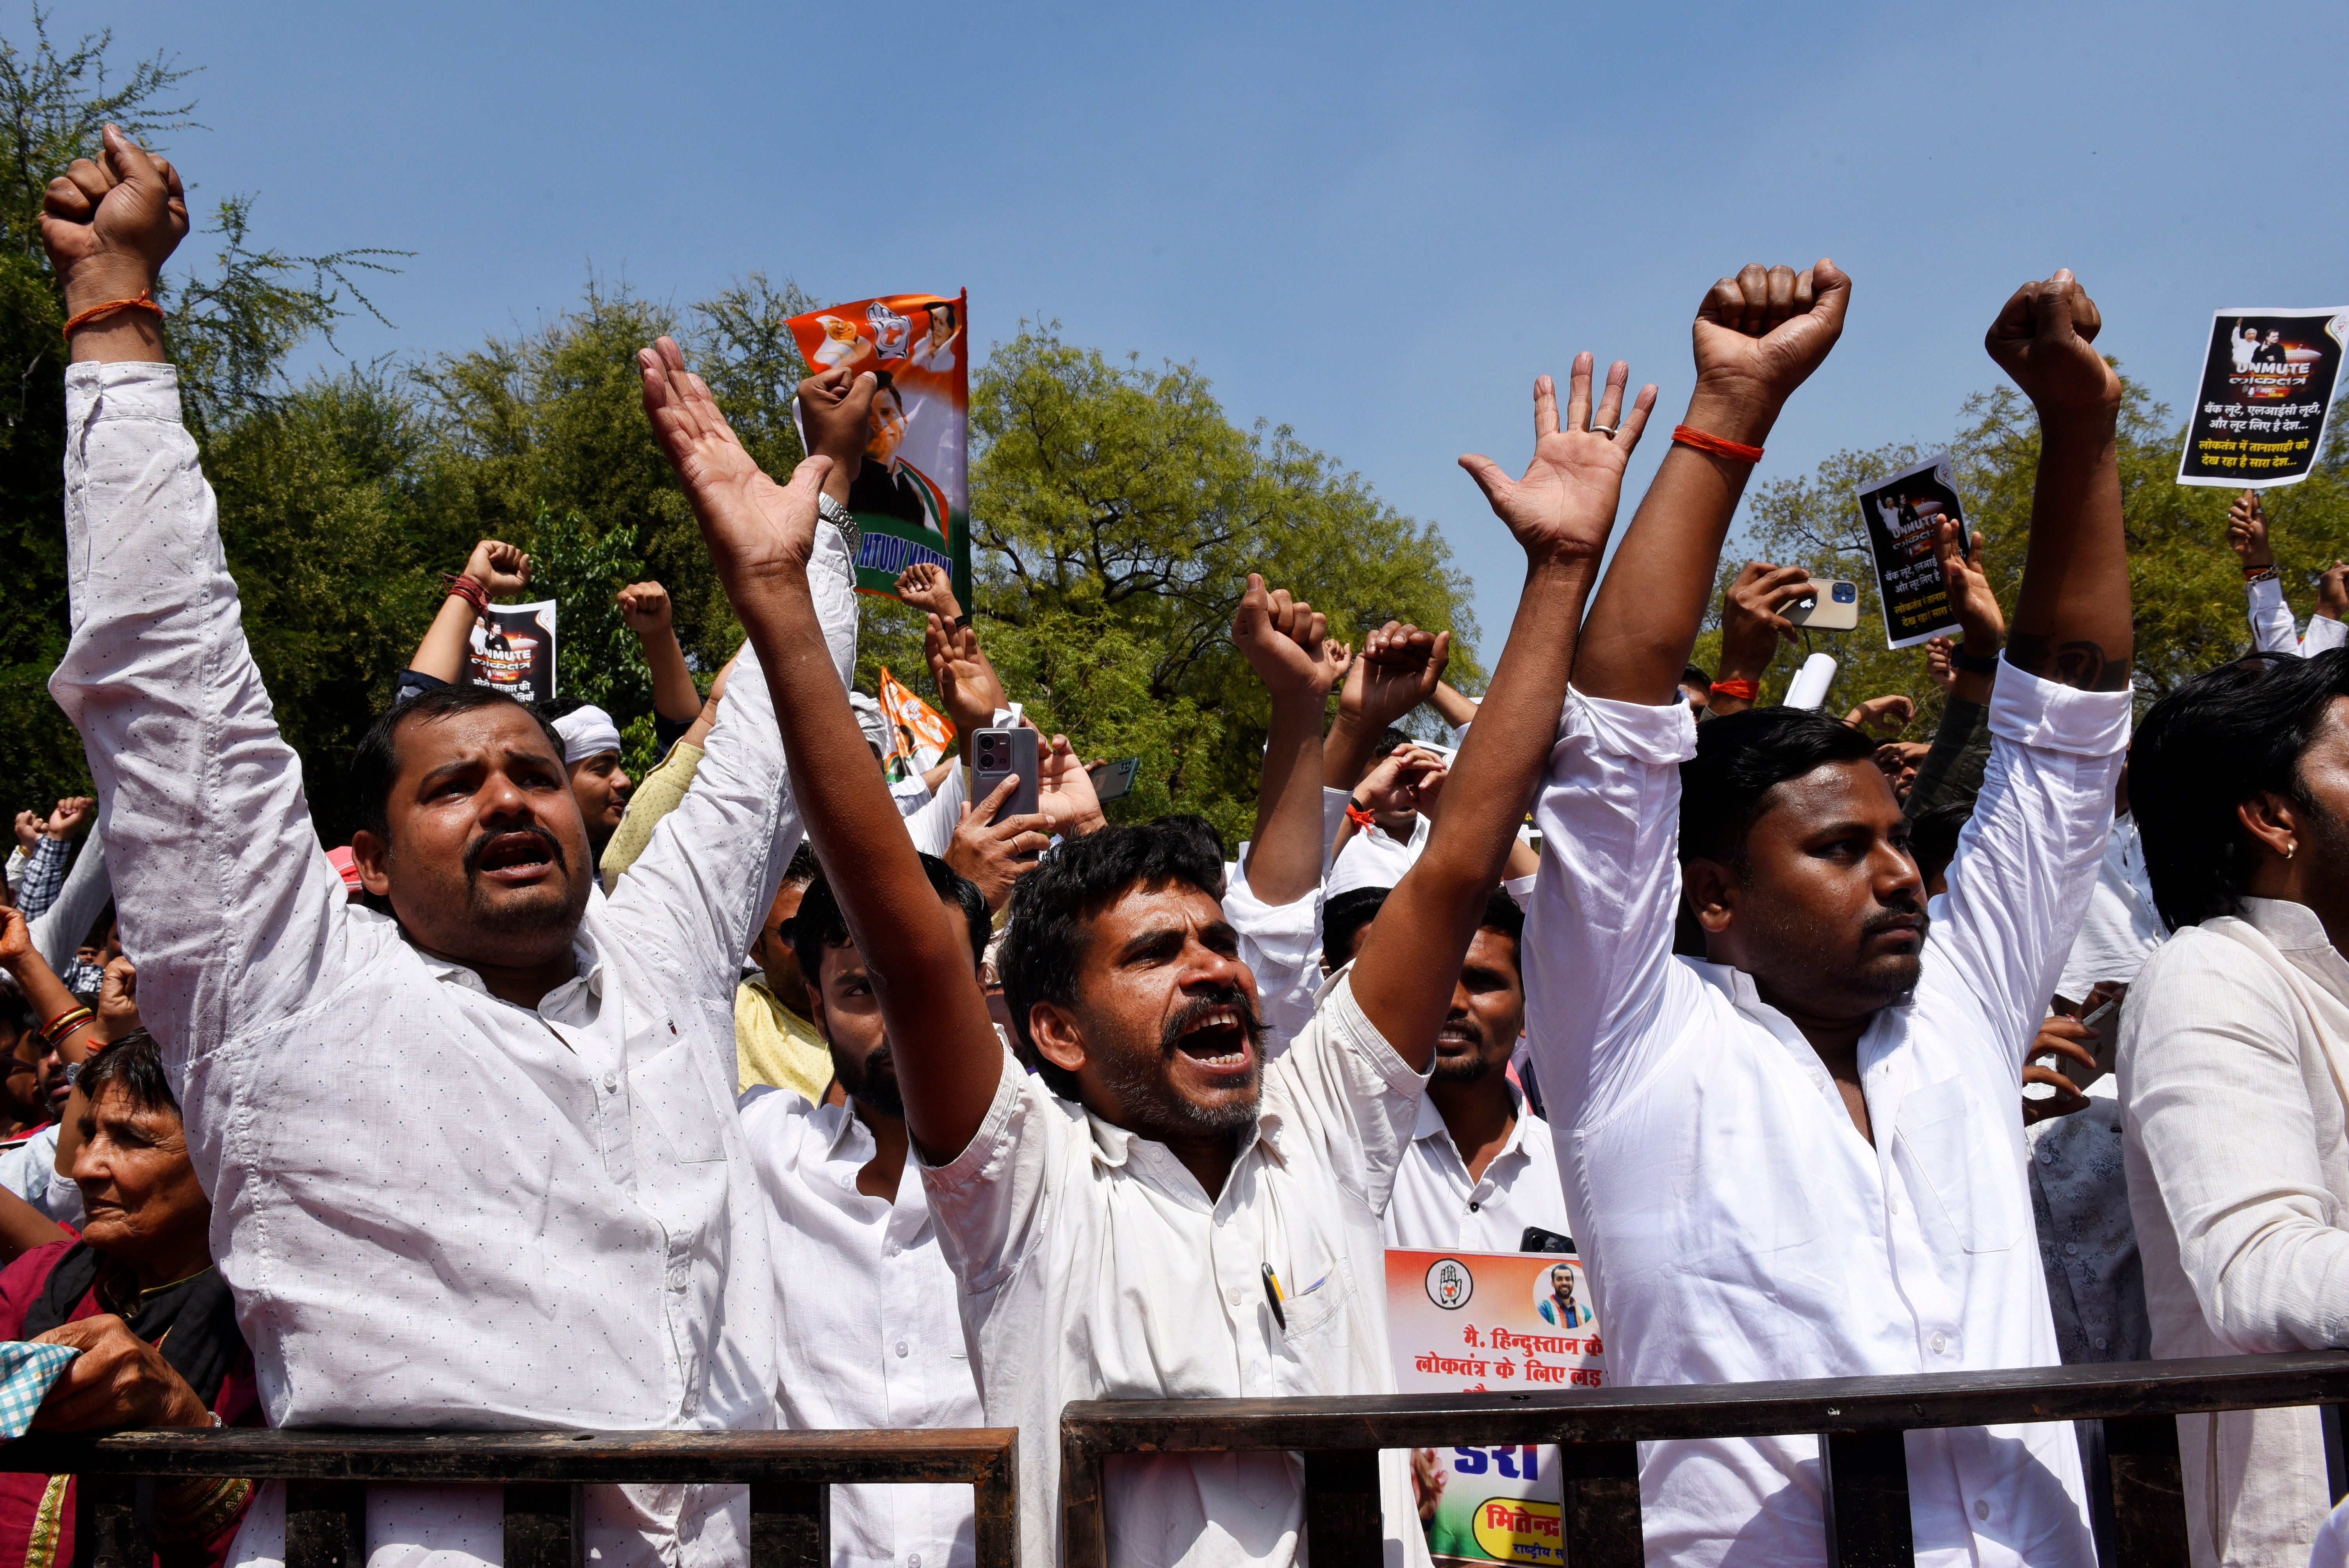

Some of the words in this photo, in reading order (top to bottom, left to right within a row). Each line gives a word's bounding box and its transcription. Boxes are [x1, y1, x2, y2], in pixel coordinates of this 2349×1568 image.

[2236, 362, 2310, 374] UNMUTE
[2204, 401, 2223, 414] बैंक
[2225, 402, 2244, 417] लूटे,
[2247, 403, 2297, 417] एलआईसी
[2299, 401, 2321, 417] लूटी,
[2209, 416, 2228, 429] और
[2230, 420, 2249, 433] लूट
[2249, 418, 2271, 433] लिए
[2272, 419, 2281, 432] है
[2199, 438, 2237, 451] लोकतंत्र
[2239, 439, 2249, 451] में
[2249, 440, 2294, 452] तानाशाही
[2295, 438, 2310, 450] को
[2201, 453, 2220, 465] देख
[2222, 456, 2238, 467] रहा
[2239, 454, 2247, 468] है
[2249, 458, 2271, 468] सारा
[1893, 513, 1937, 538] UNMUTE
[1885, 570, 1899, 581] बैंक
[1914, 554, 1938, 572] एलआई
[1895, 581, 1909, 593] और
[1919, 574, 1933, 586] लिए
[1933, 569, 1941, 581] है
[1894, 599, 1922, 614] लोकतंत्र
[1902, 616, 1916, 627] देख
[1931, 606, 1948, 617] सारा
[475, 645, 531, 661] UNMUTE
[491, 683, 517, 693] सरकार
[519, 681, 531, 691] की
[1490, 1327, 1581, 1357] हिन्दुस्तान
[1582, 1334, 1603, 1356] के
[1415, 1351, 1490, 1377] लोकतंत्र
[1494, 1357, 1516, 1379] के
[1524, 1360, 1565, 1383] लिए
[1513, 1542, 1552, 1560] राष्ट्रीय
